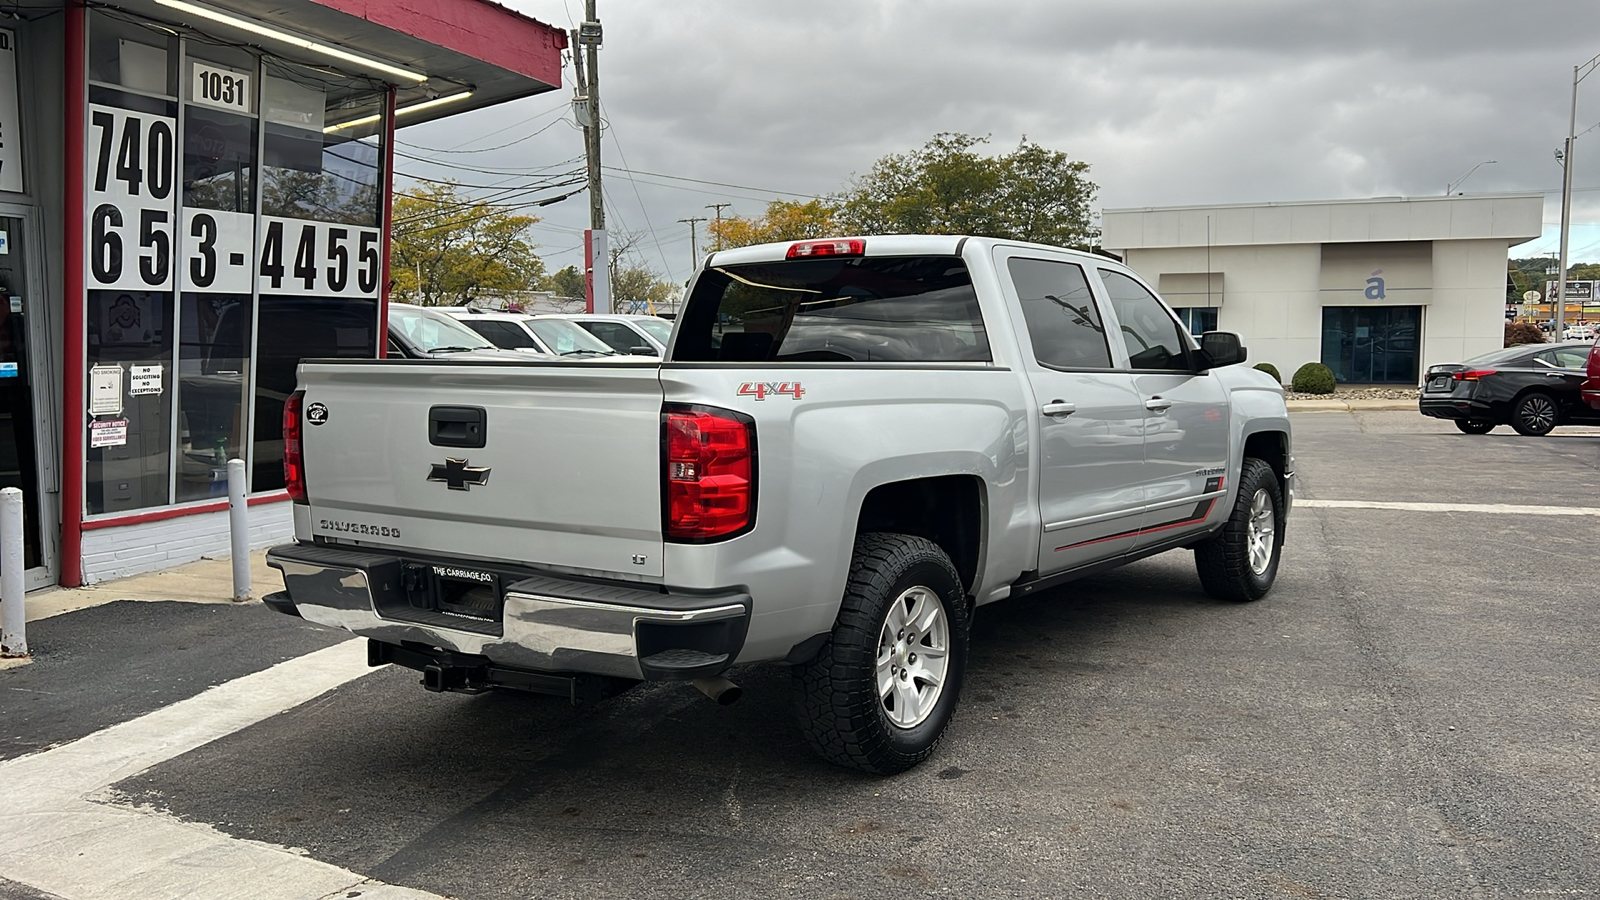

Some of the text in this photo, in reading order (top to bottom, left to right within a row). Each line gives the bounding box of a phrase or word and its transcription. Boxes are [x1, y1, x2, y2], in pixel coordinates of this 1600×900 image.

[200, 71, 244, 106] 1031
[92, 110, 172, 199] 740
[320, 519, 401, 539] SILVERADO
[632, 553, 647, 565] LT
[432, 566, 493, 582] THE CARRIAGE CO.
